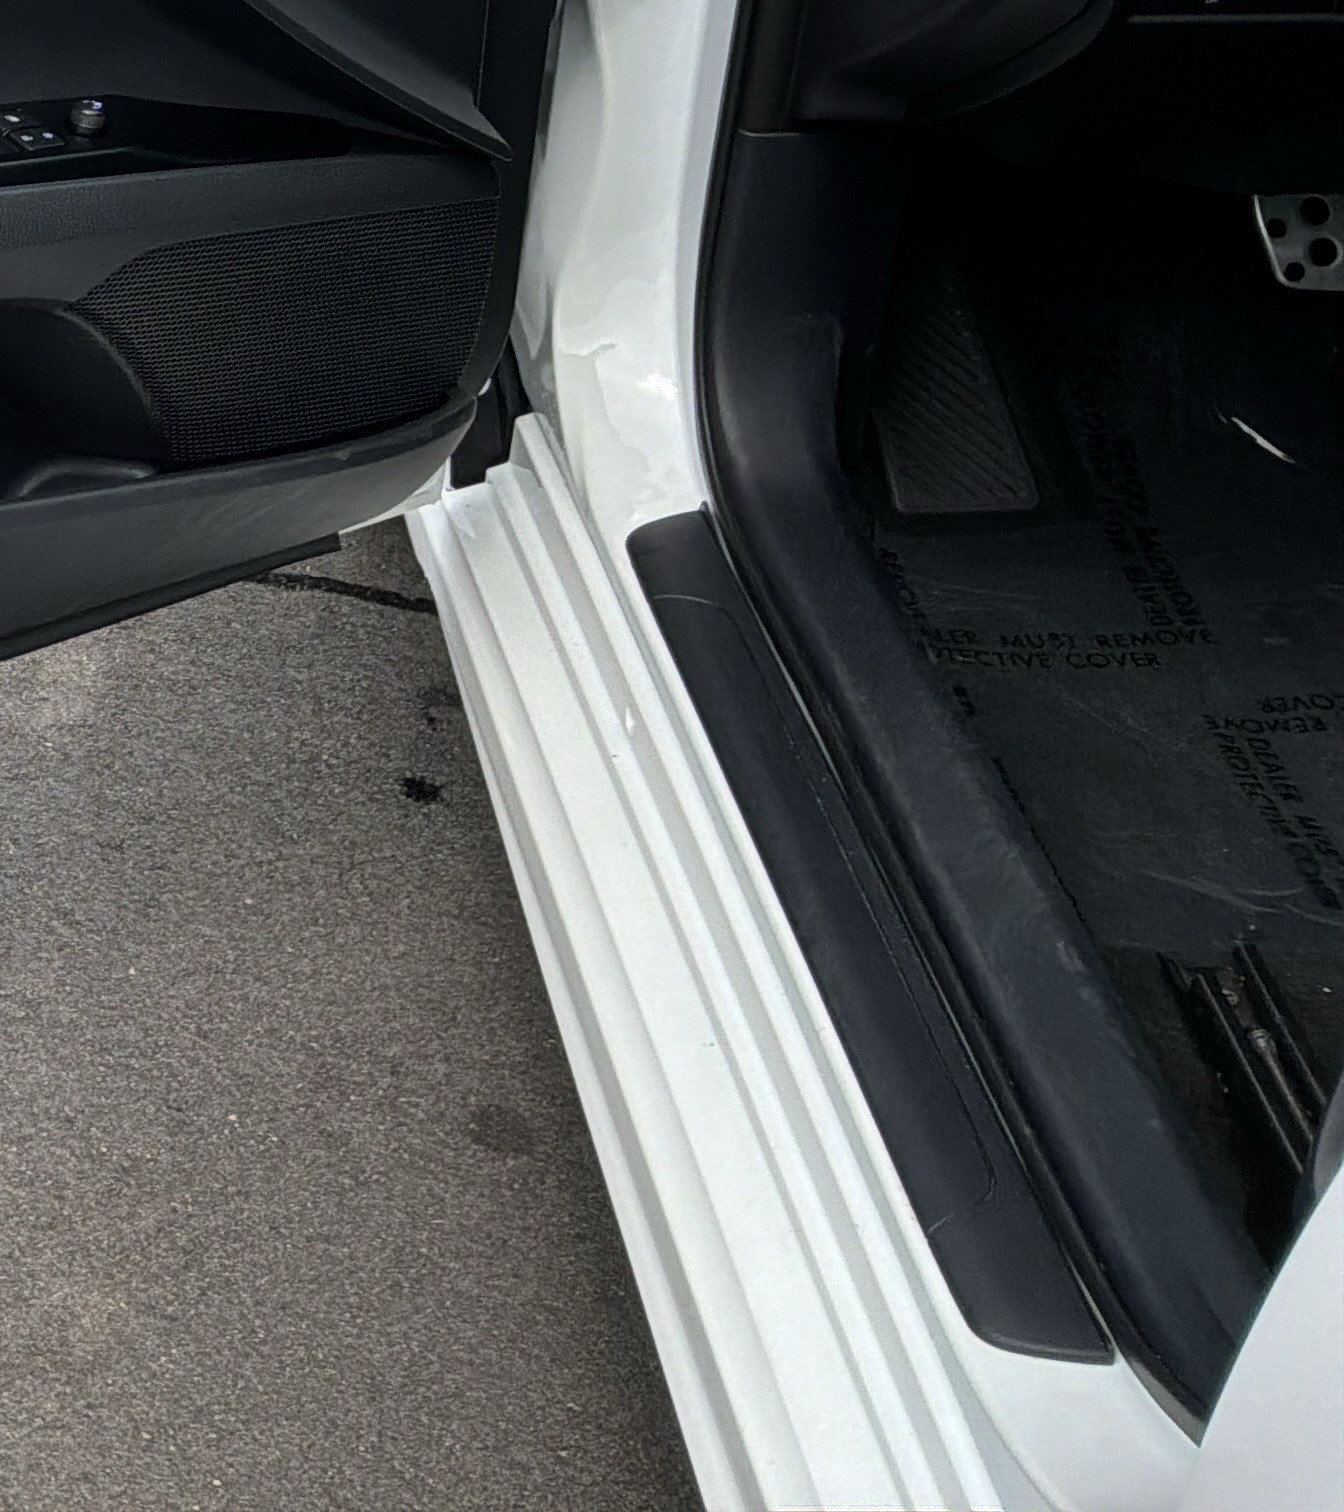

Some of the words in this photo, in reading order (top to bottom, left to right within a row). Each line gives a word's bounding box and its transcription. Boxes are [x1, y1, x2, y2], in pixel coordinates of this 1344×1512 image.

[999, 632, 1076, 650] MUST
[1096, 628, 1216, 647] REMOVE
[1065, 651, 1163, 670] COVER
[1201, 713, 1328, 734] REMOVE
